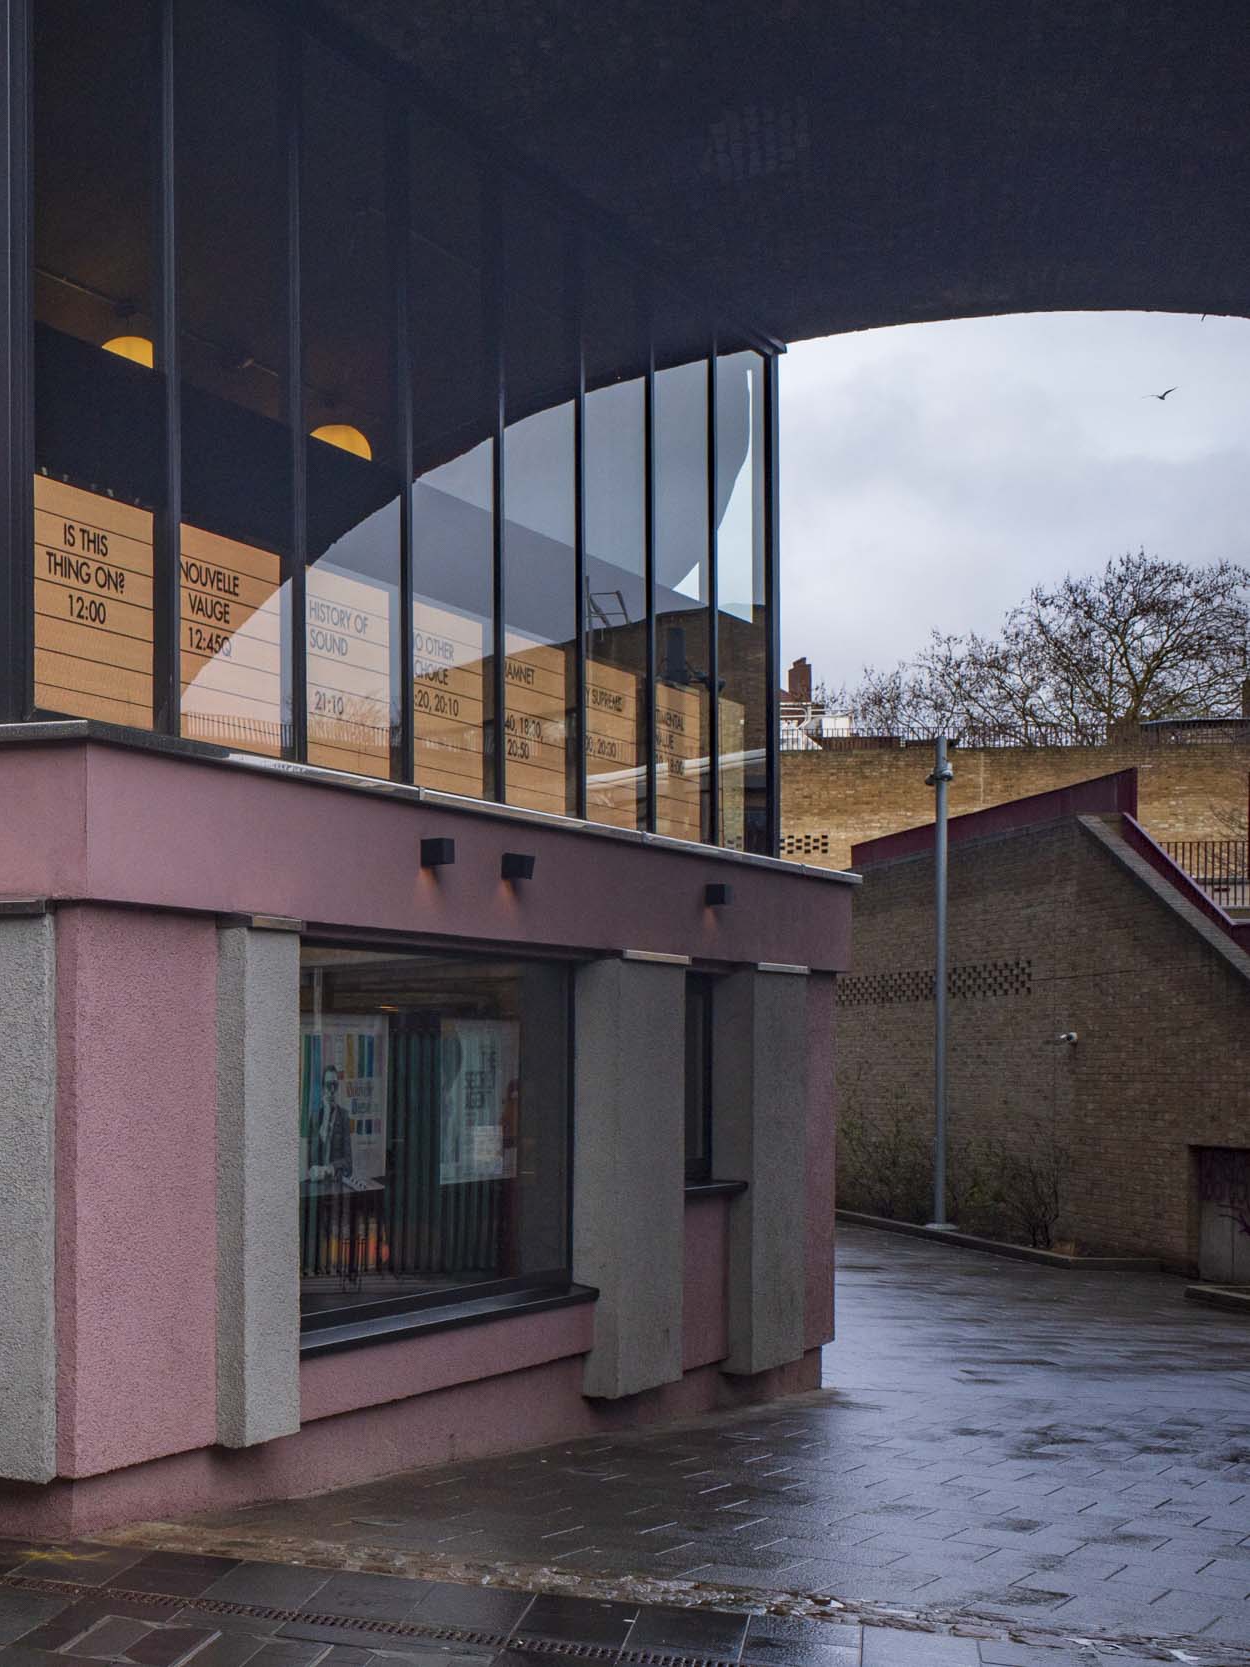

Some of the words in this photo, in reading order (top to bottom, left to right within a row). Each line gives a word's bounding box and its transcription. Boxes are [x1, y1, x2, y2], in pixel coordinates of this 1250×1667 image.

[63, 523, 76, 547] IS
[79, 528, 109, 557] THIS
[46, 551, 91, 585] THING
[94, 566, 125, 594] ON?
[180, 563, 240, 598] NOUVELLE
[68, 593, 107, 625] 12:00
[188, 592, 231, 626] VAUGE
[308, 598, 351, 630] HISTORY
[354, 613, 369, 636] OF
[309, 630, 349, 658] SOUND
[426, 637, 455, 662] OTHER
[415, 659, 448, 686] CHOICE
[314, 690, 345, 717] 21:10
[435, 693, 459, 717] 20:10
[507, 739, 530, 760] 20:50
